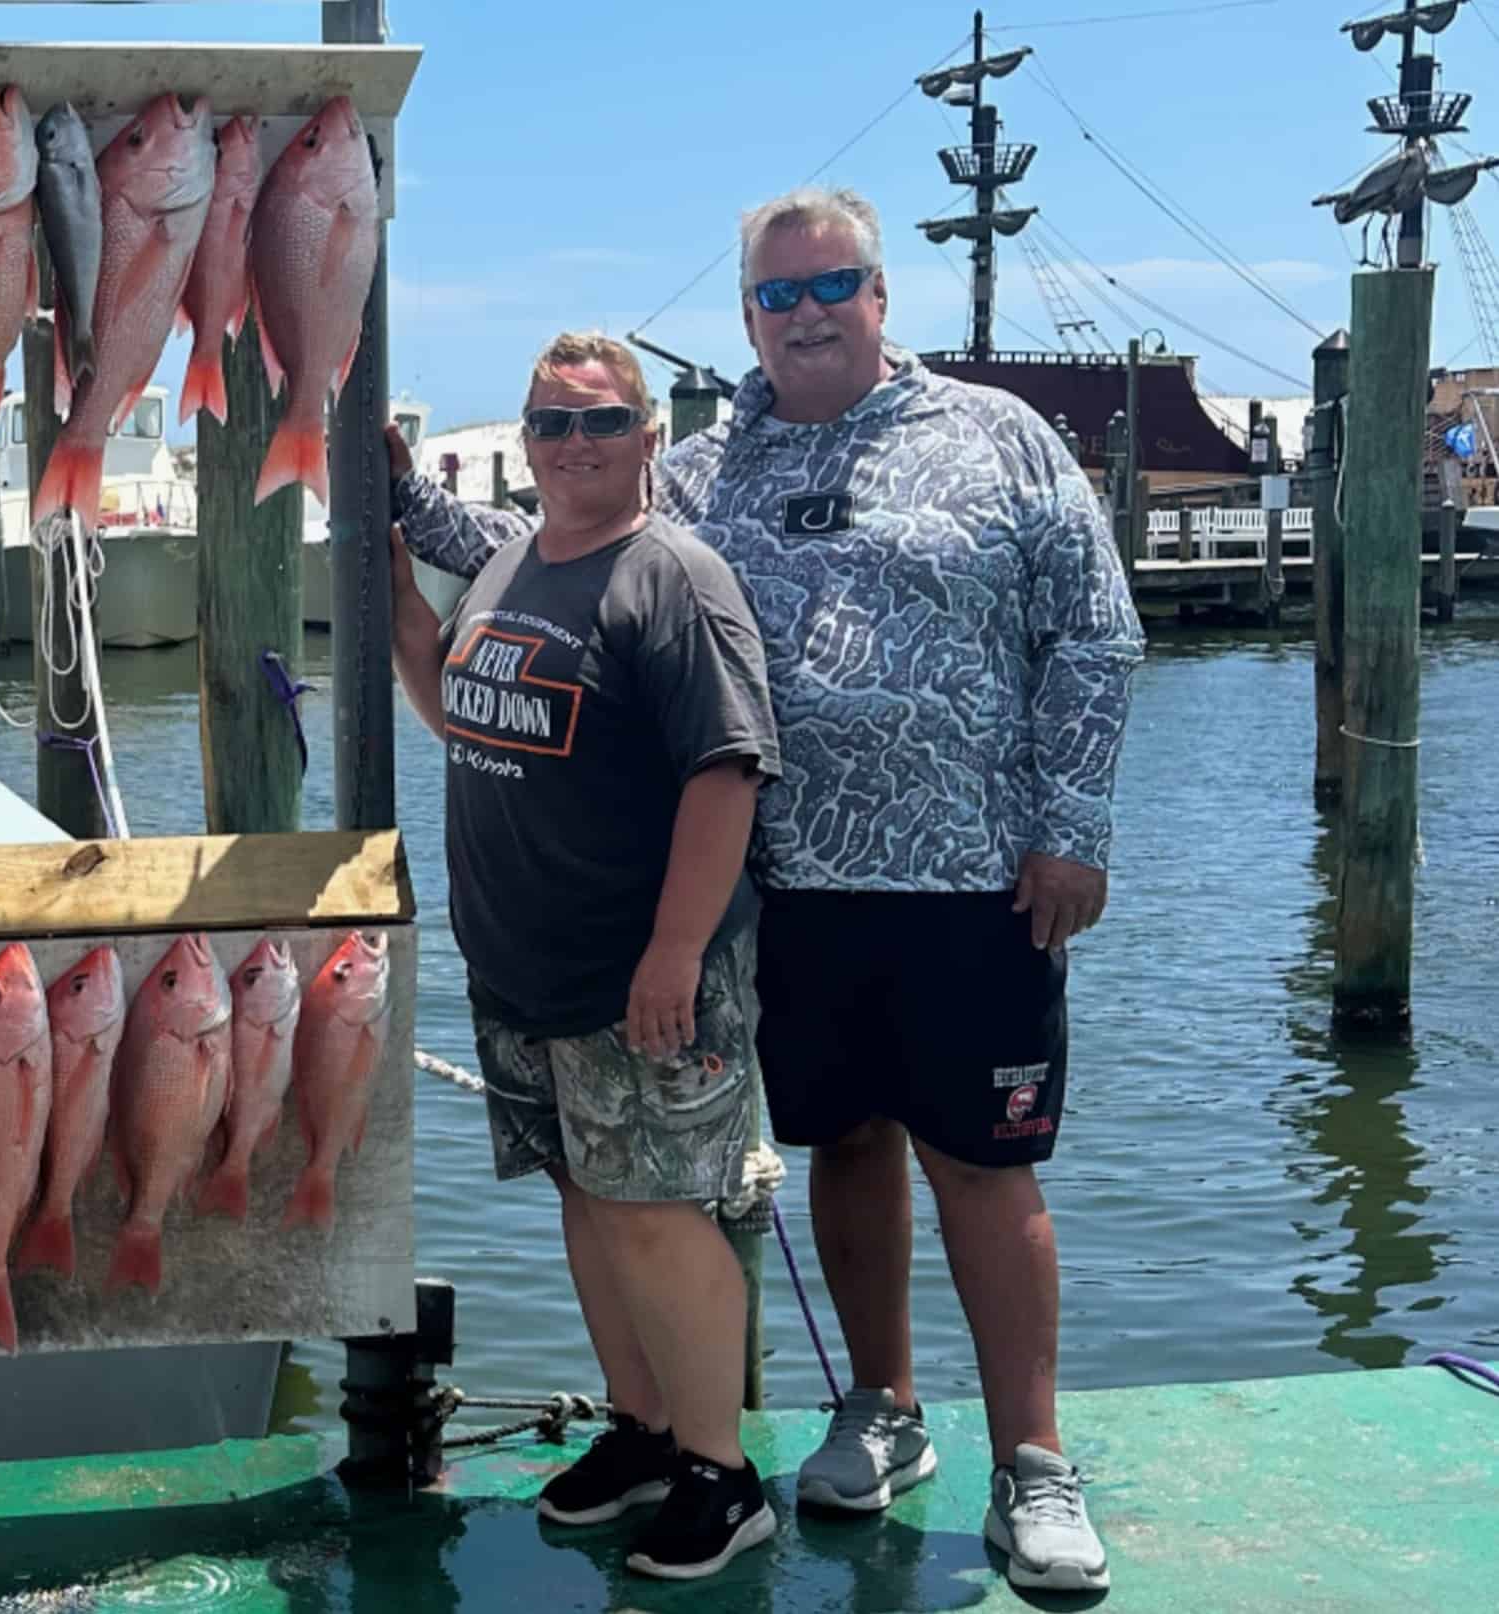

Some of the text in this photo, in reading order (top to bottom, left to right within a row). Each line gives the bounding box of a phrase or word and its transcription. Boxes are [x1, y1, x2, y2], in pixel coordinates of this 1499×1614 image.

[469, 638, 524, 683] NEVER
[444, 674, 551, 738] OCKED DOWN
